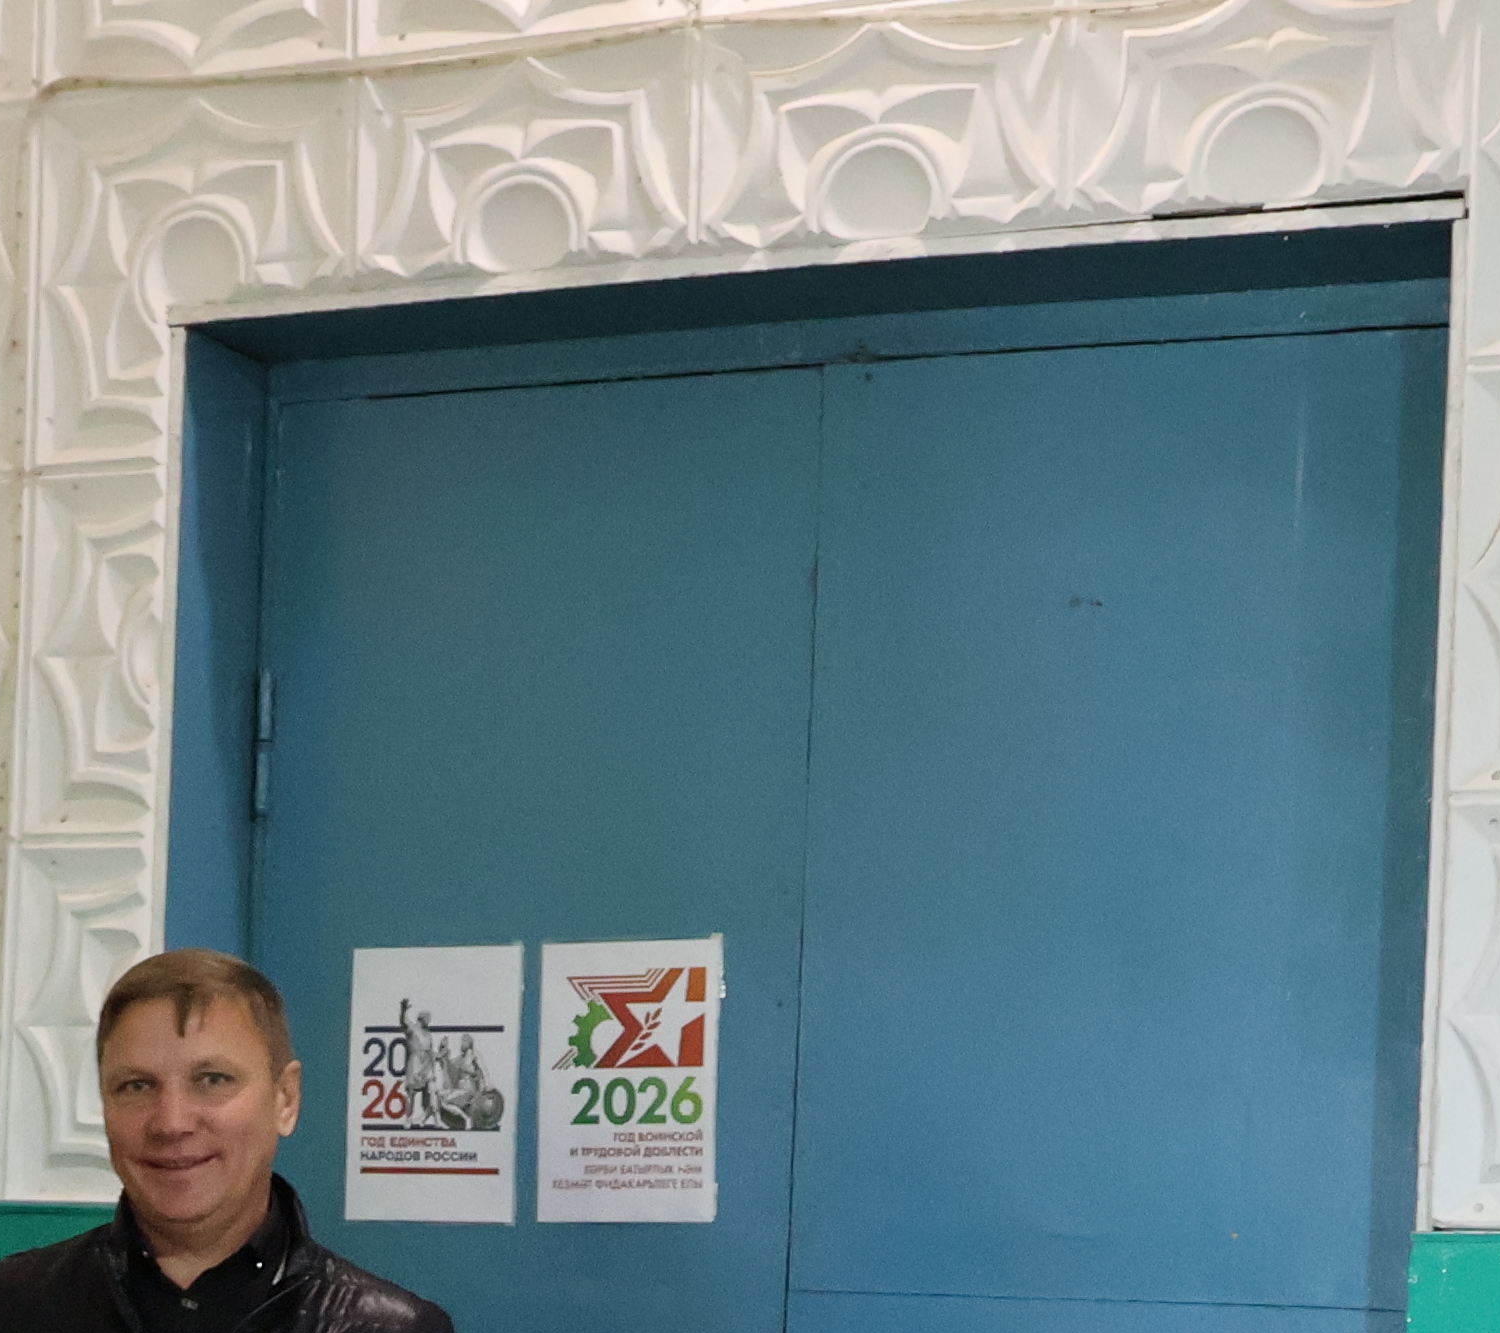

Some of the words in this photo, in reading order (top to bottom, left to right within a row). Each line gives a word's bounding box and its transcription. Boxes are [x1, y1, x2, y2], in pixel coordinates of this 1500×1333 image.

[361, 1079, 409, 1120] 26
[570, 1076, 704, 1126] 2026
[361, 1136, 386, 1148] ГОД
[360, 1150, 421, 1162] НАРОДОВ
[424, 1151, 478, 1162] РОССИИ
